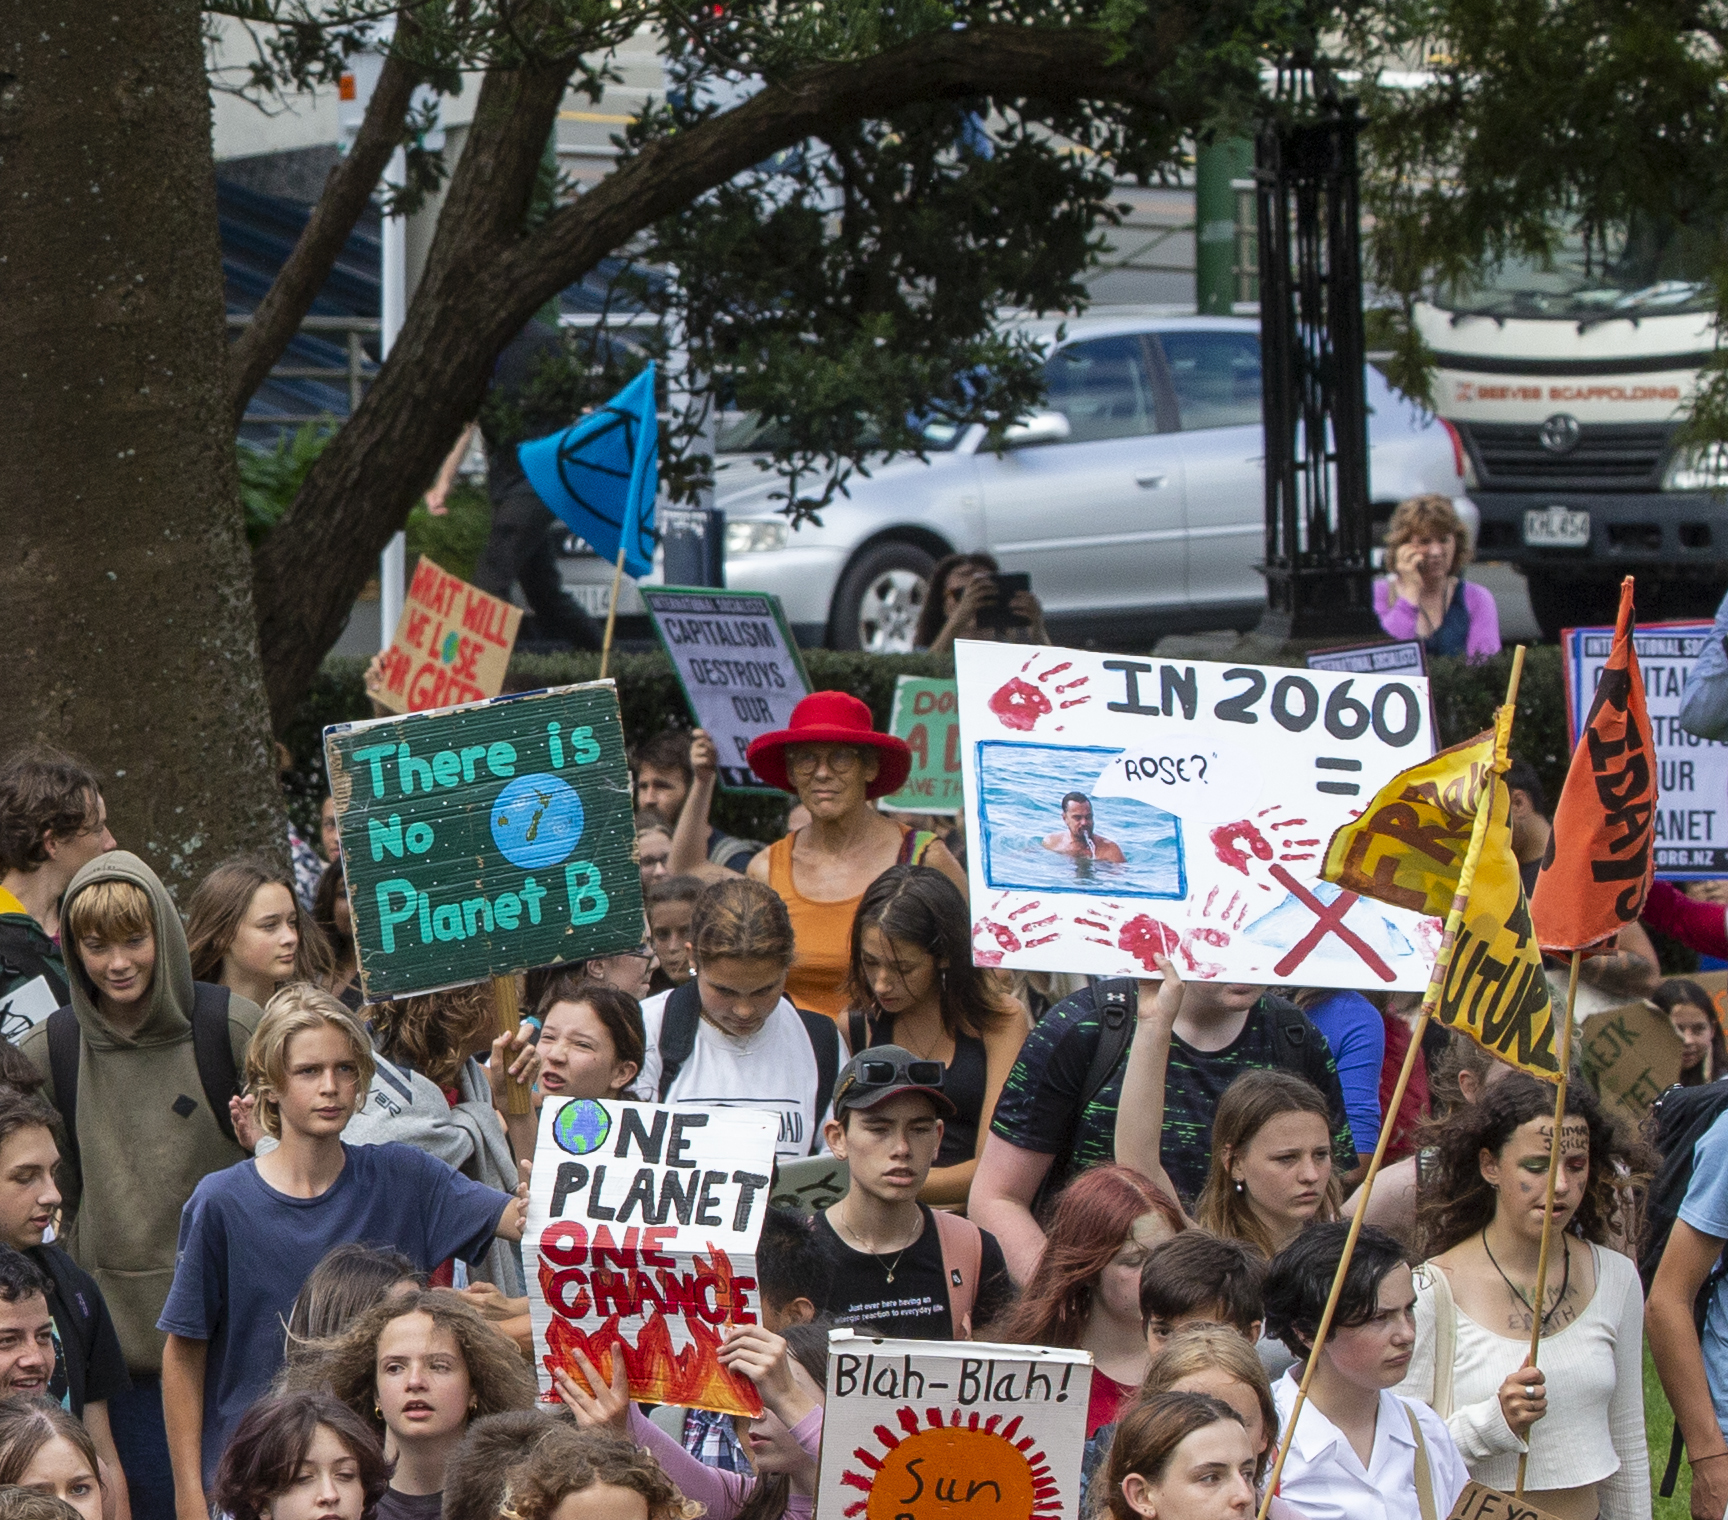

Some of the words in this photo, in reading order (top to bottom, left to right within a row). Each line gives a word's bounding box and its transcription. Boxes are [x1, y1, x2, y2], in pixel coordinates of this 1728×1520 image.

[461, 589, 510, 648] WILL
[664, 617, 777, 648] CAPITALISM
[689, 658, 786, 689] DESTROYS
[731, 695, 775, 724] OUR
[1102, 660, 1197, 720] IN
[1214, 667, 1420, 747] 2060
[352, 740, 518, 799] There
[547, 721, 601, 769] is
[1661, 761, 1695, 791] UR
[368, 812, 435, 862] No
[1654, 810, 1716, 841] ANET
[374, 875, 547, 954] Planet
[563, 859, 610, 927] B
[549, 1161, 769, 1232] PLANET
[540, 1220, 678, 1269] ONE
[548, 1267, 757, 1325] CHANCE
[899, 1457, 1001, 1504] Sun
[1461, 1490, 1501, 1520] IF
